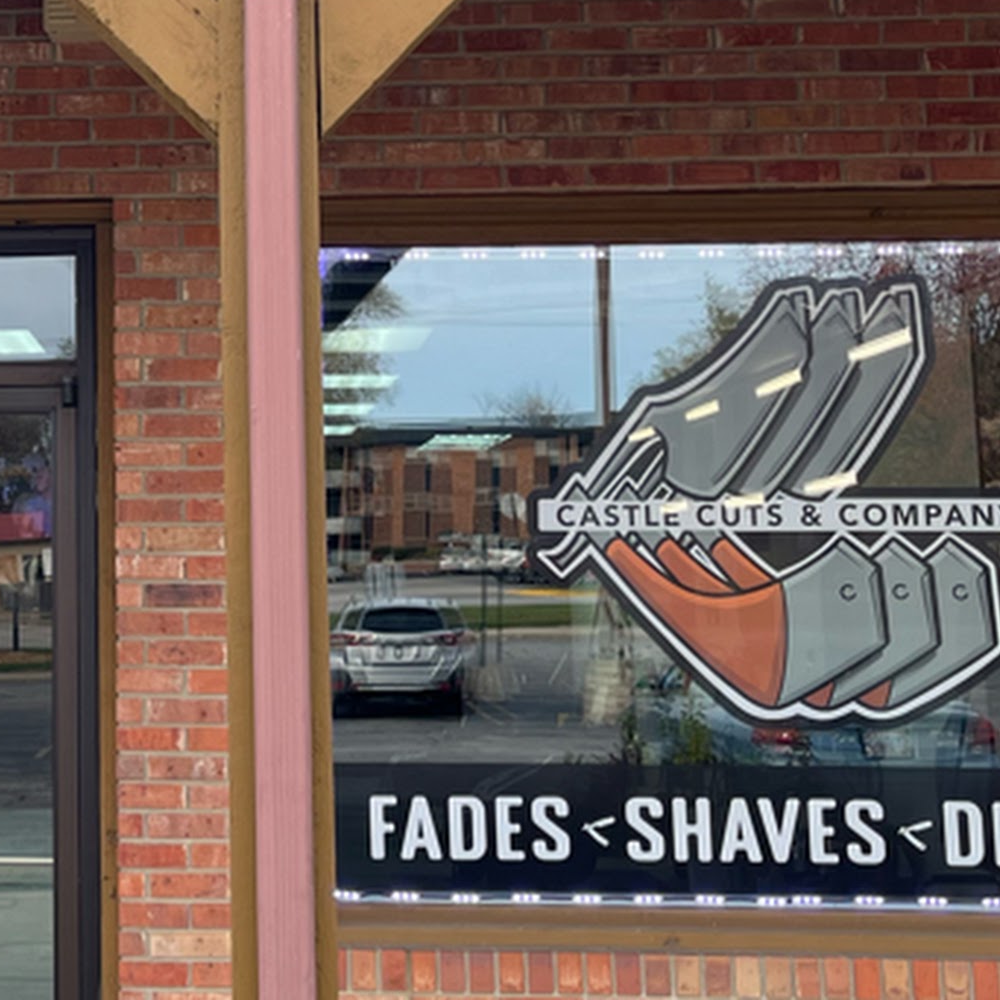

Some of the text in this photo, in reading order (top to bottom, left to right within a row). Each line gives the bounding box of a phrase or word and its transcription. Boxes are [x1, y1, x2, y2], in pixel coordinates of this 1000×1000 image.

[556, 504, 681, 527] CASTLE
[696, 503, 783, 528] CUTS
[800, 504, 822, 527] &
[368, 795, 1000, 868] FADES SHAVES D
